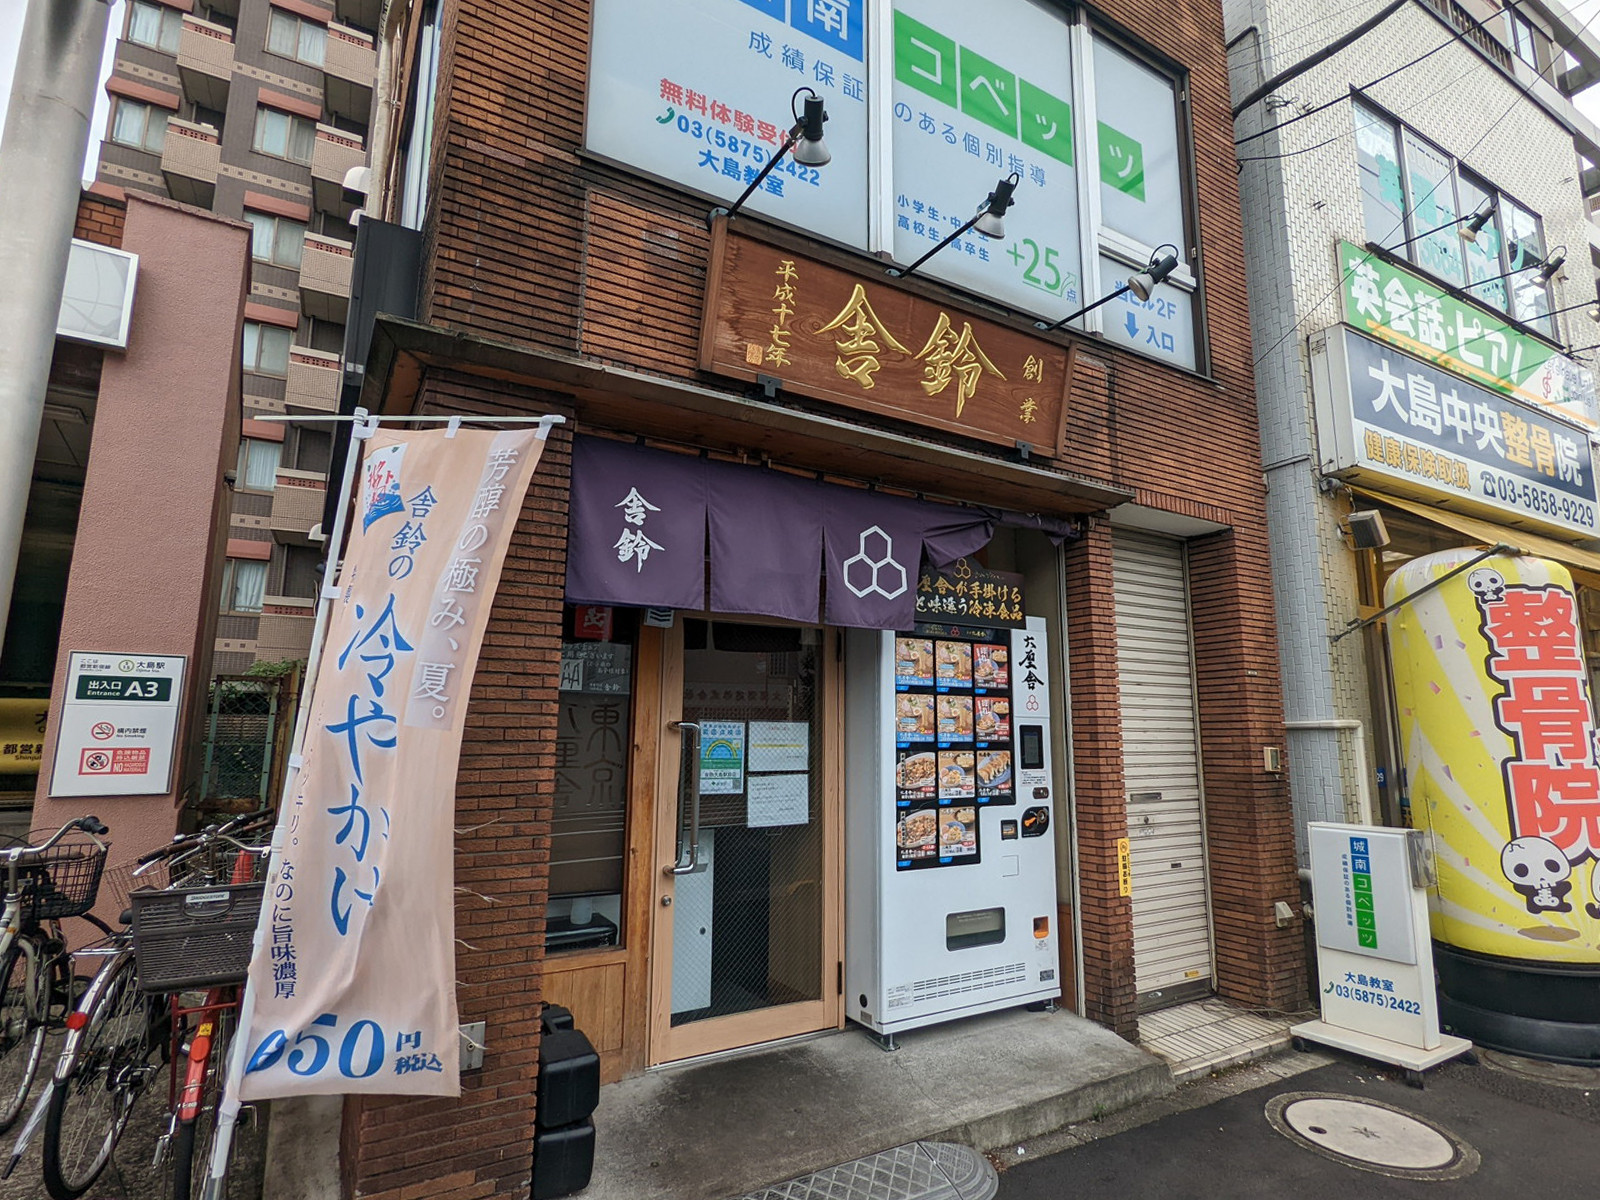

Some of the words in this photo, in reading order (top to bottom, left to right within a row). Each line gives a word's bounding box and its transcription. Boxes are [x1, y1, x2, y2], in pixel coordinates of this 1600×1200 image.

[749, 31, 864, 102] 成績保証
[894, 102, 1046, 188] のある個別指導
[910, 36, 1133, 179] コベッツ
[677, 115, 820, 187] 03(5875)2422
[698, 150, 785, 198] 大島教室
[1005, 238, 1061, 291] +25
[1066, 288, 1078, 304] 点
[766, 259, 799, 367] 平成十七年
[1146, 324, 1175, 353] 入口
[1348, 256, 1523, 384] 英会話・ピアノ
[1019, 354, 1044, 425] 創業
[1367, 359, 1583, 488] 大島中央整骨院
[1364, 429, 1472, 493] 健康保険取扱
[389, 485, 438, 581] 舎鈴の
[613, 486, 665, 574] 舎鈴
[1498, 476, 1595, 529] 03-5858-9229
[412, 448, 518, 720] 芳醇の極み、夏。
[88, 680, 122, 690] 出入口
[124, 681, 159, 697] A3
[136, 661, 166, 670] 大島駅
[1019, 635, 1045, 690] 六厘舎
[1489, 588, 1600, 851] 整骨院
[1353, 840, 1373, 944] 城南コベッツ
[271, 859, 297, 1000] なのに旨味濃厚
[1335, 984, 1421, 1016] 03(5875)2422
[1344, 971, 1394, 992] 大島教室
[394, 1052, 443, 1076] 税込
[396, 1030, 422, 1053] 円
